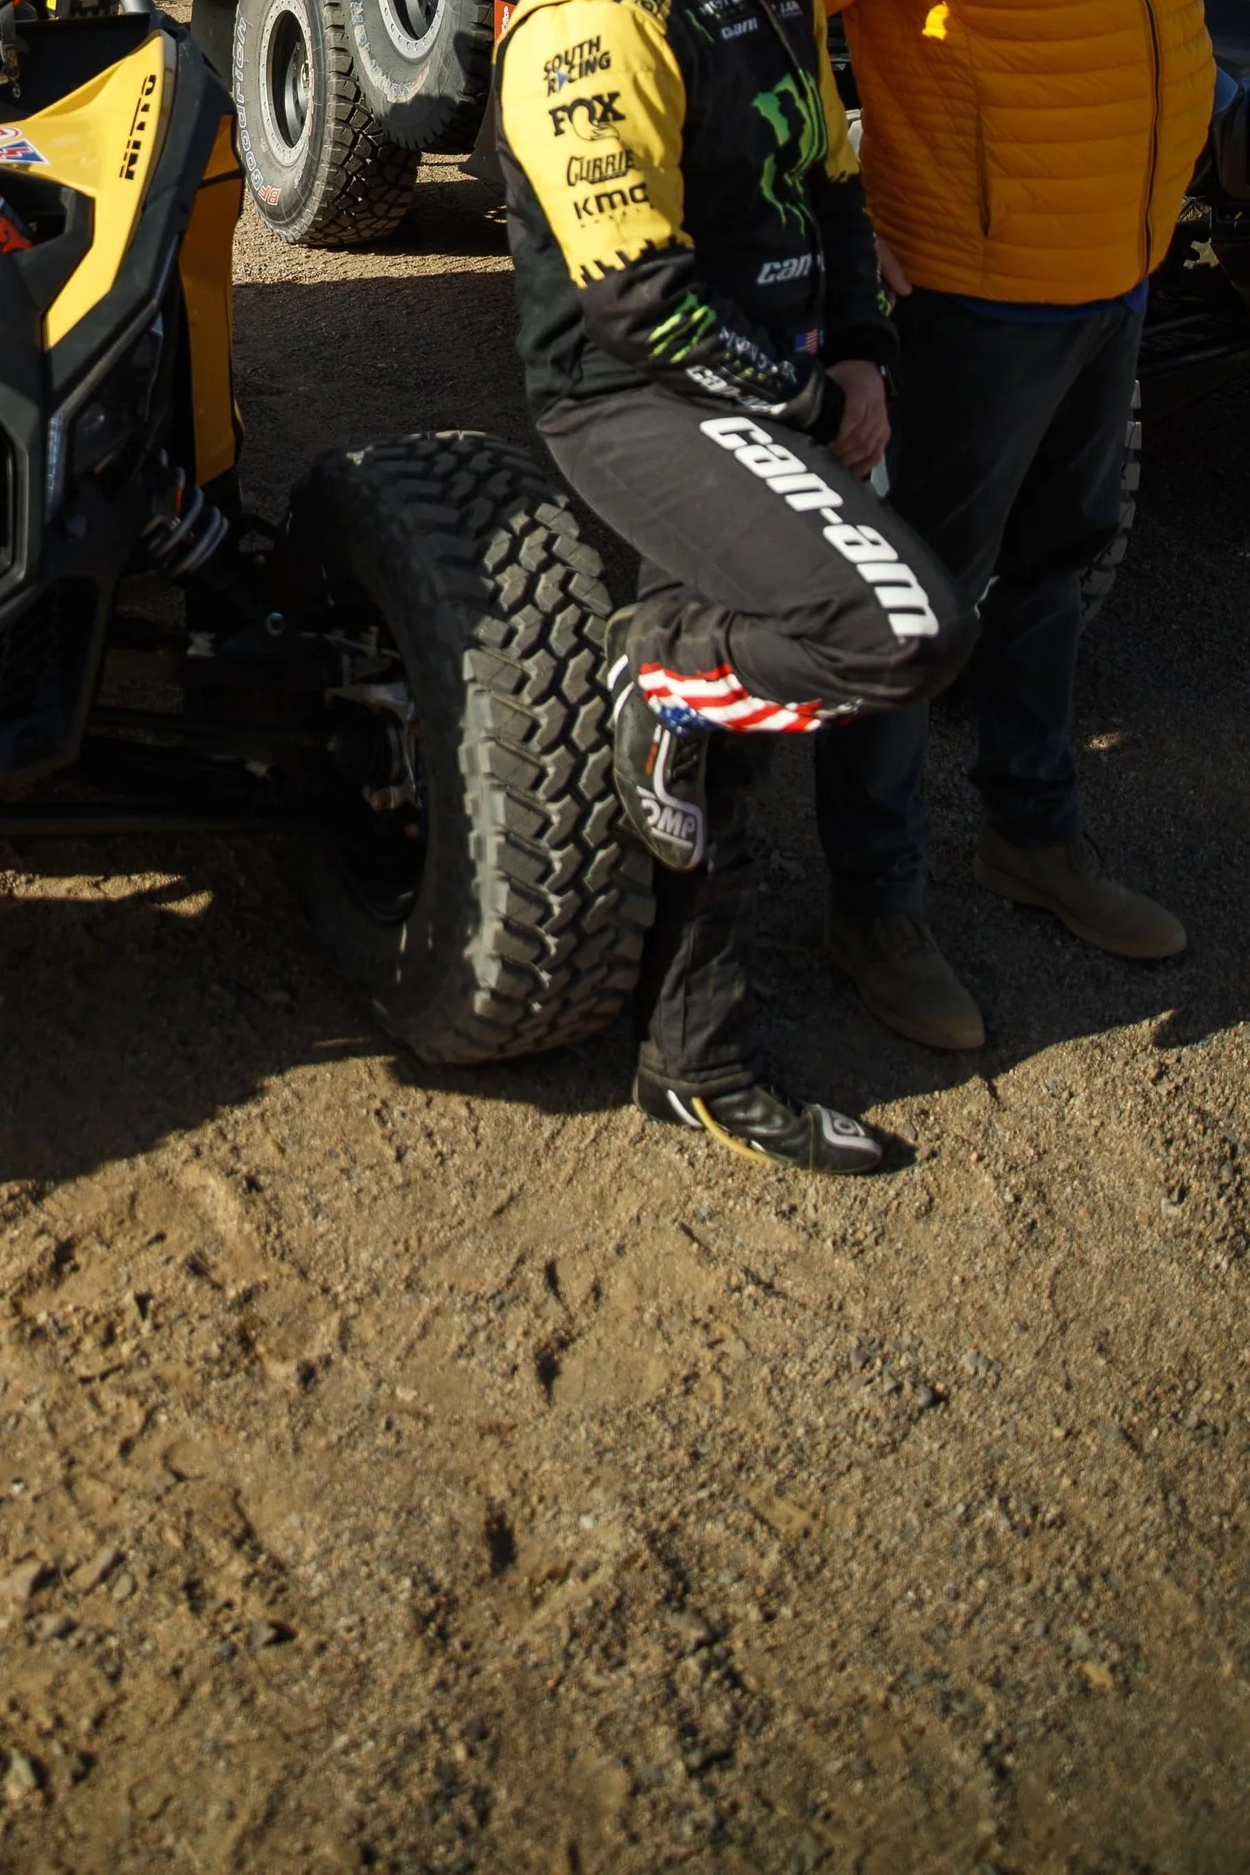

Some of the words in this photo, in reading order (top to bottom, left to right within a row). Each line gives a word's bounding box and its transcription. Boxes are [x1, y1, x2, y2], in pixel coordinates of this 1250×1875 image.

[543, 34, 602, 81] SOUTH
[548, 90, 626, 138] FOX
[699, 416, 940, 640] can-am
